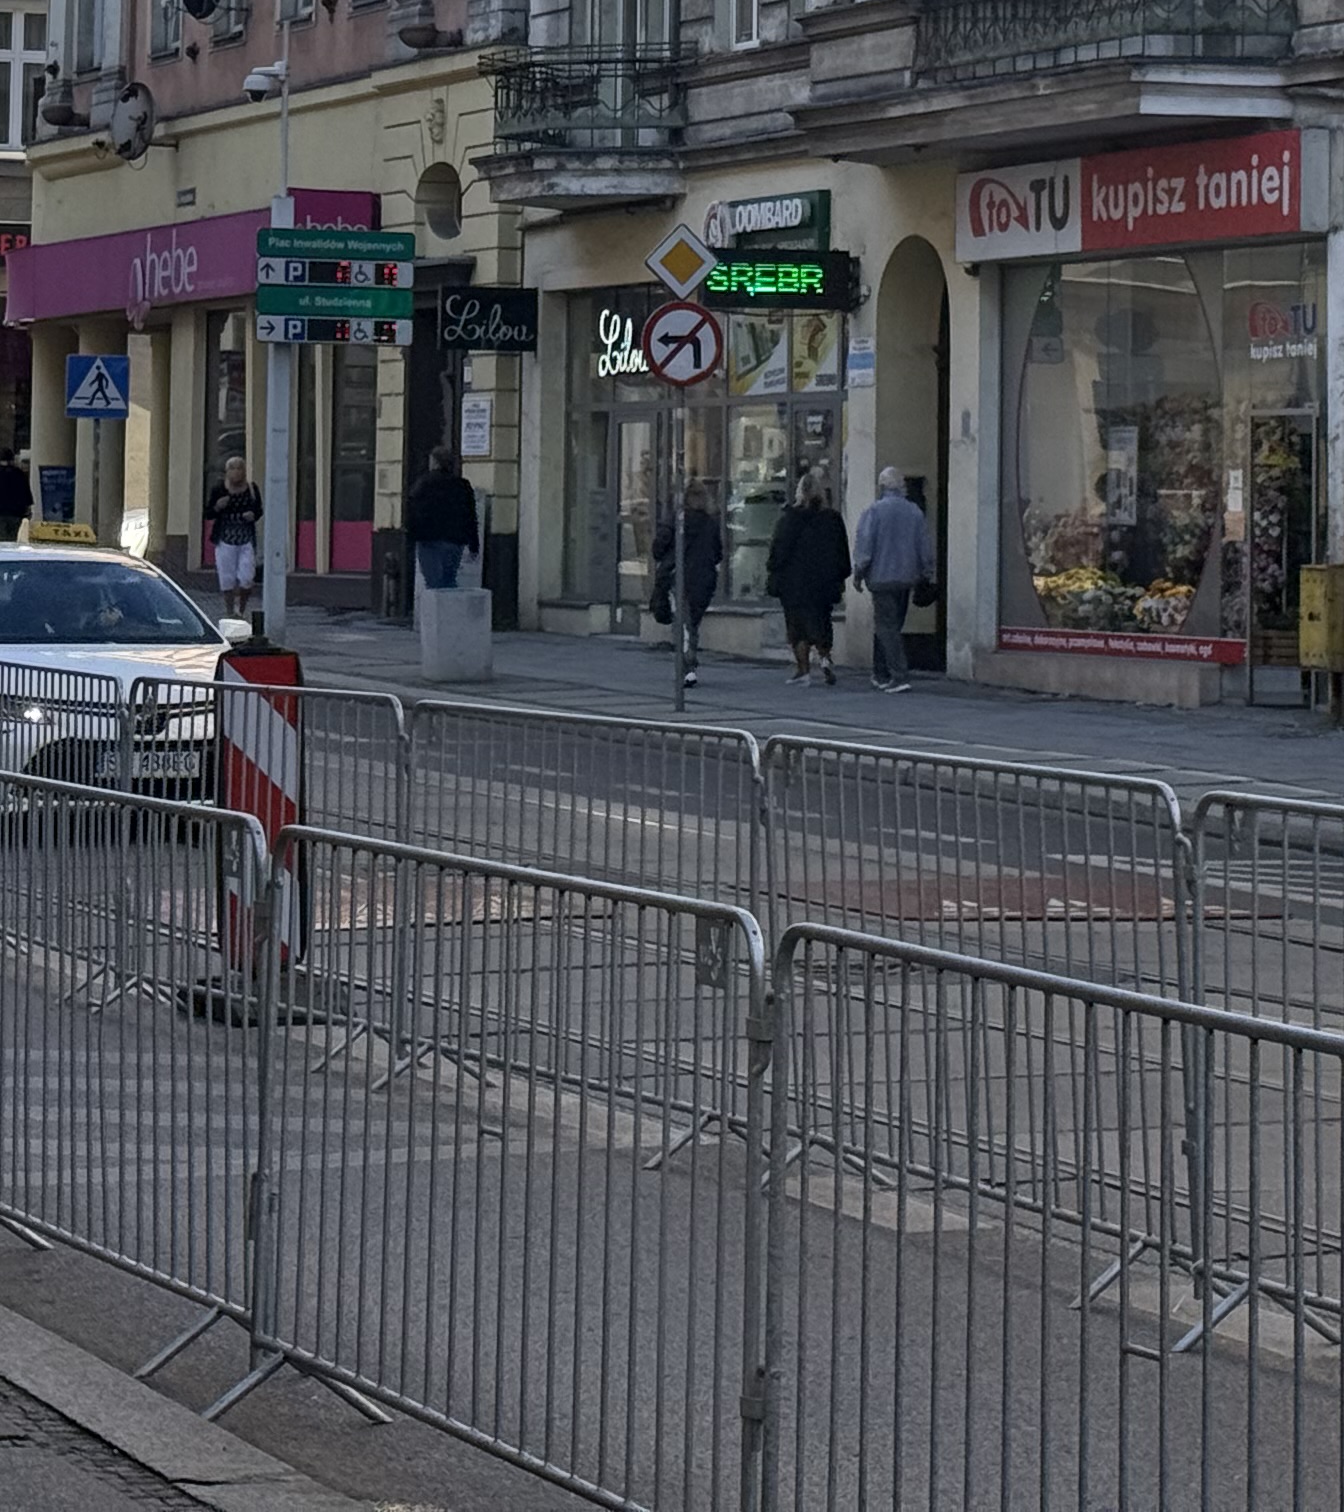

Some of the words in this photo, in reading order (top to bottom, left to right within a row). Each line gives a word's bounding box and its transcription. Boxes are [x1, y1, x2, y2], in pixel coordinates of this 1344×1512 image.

[1092, 167, 1186, 231] kupisz
[1196, 150, 1291, 217] taniej
[268, 237, 290, 248] Plac
[293, 238, 344, 249] Inwalidów
[347, 240, 404, 252] Wojennych
[145, 228, 198, 298] hebe
[314, 296, 372, 308] Studzienna
[444, 294, 534, 341] Lilou
[52, 528, 90, 538] TAXI
